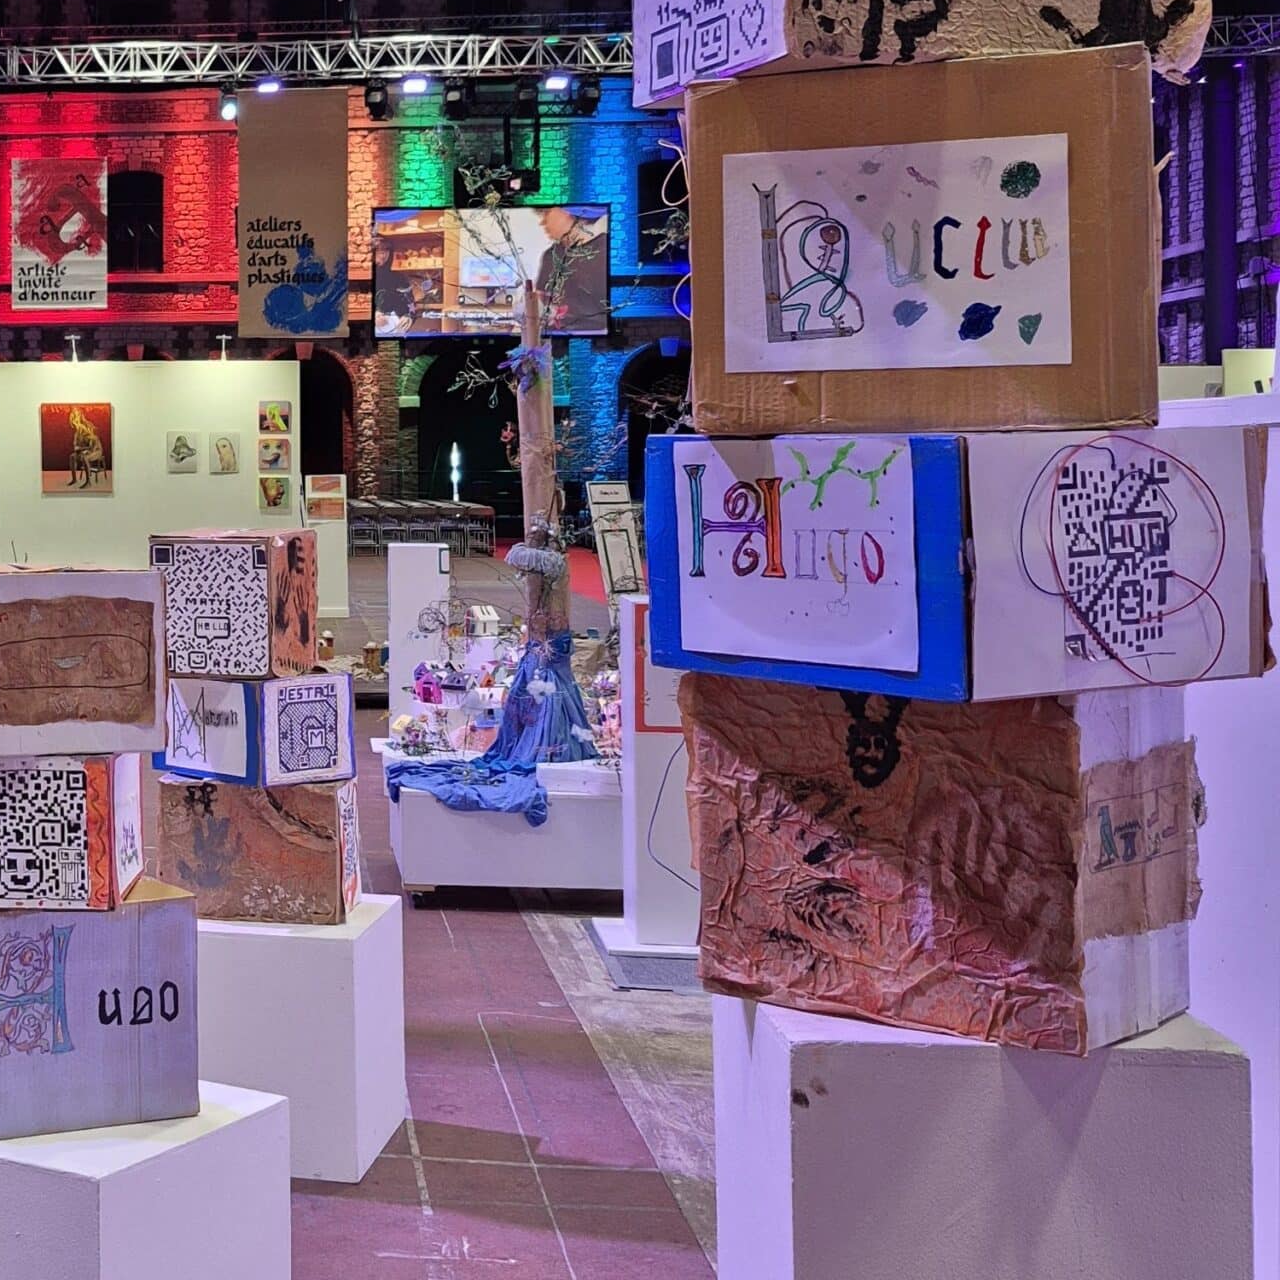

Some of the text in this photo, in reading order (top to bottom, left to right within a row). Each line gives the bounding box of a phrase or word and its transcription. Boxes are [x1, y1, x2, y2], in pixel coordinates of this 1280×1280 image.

[246, 215, 302, 233] ateliers
[246, 233, 315, 250] éducatifs
[247, 251, 288, 267] d'arts
[17, 263, 68, 278] artiste
[247, 269, 326, 288] plastiques
[18, 288, 97, 301] d'honneur
[197, 622, 230, 632] HELLO
